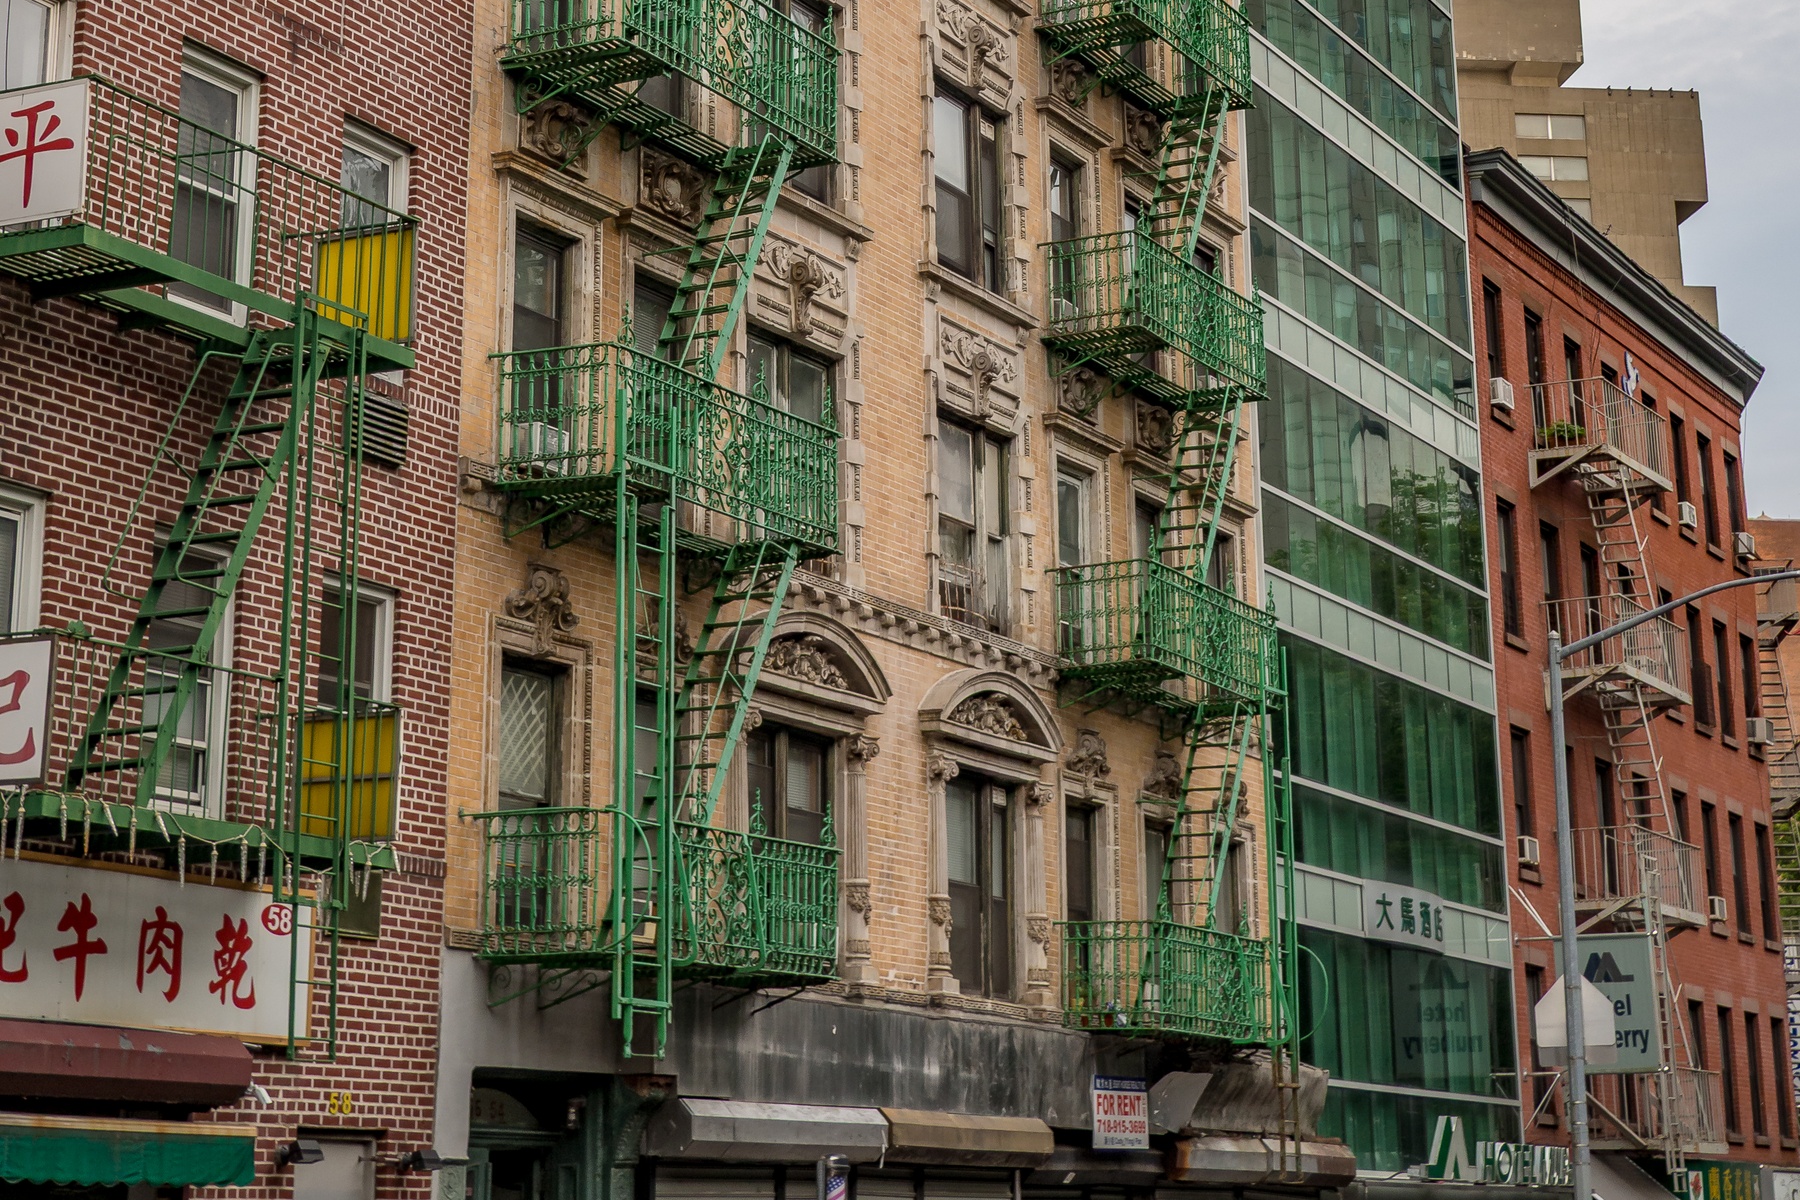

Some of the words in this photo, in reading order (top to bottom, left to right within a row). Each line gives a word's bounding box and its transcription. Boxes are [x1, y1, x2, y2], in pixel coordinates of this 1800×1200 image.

[0, 101, 74, 209] 平
[267, 909, 292, 934] 58
[1376, 893, 1443, 942] 大馬酒店
[330, 1092, 352, 1115] 58
[1097, 1094, 1115, 1115] FOR
[1117, 1095, 1141, 1116] RENT
[1476, 1141, 1538, 1185] HOTEL
